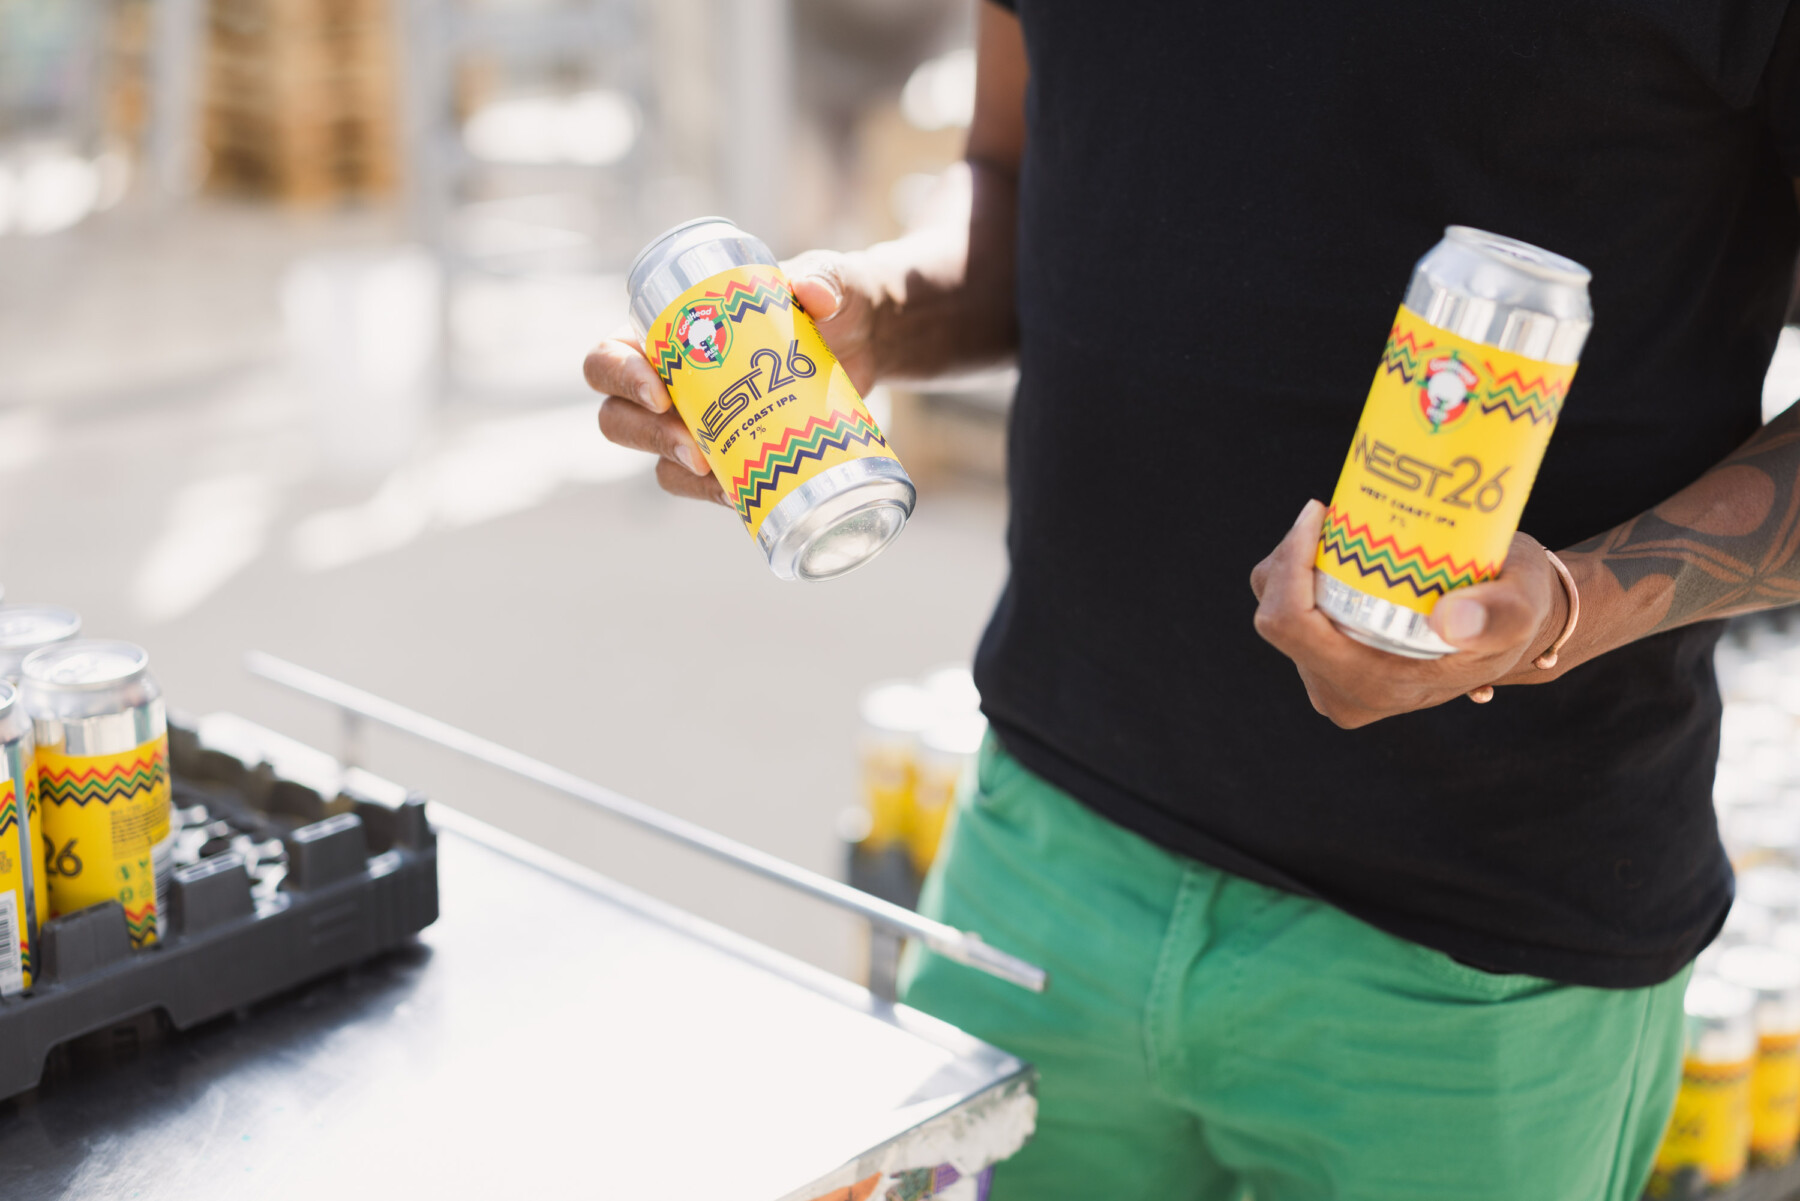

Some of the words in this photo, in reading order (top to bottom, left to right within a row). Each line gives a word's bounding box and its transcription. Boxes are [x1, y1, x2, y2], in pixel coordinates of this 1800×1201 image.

[678, 307, 712, 336] CoolHead
[720, 429, 742, 455] WEST
[741, 403, 774, 431] COAST
[776, 394, 798, 408] IPA
[749, 424, 767, 440] 7%
